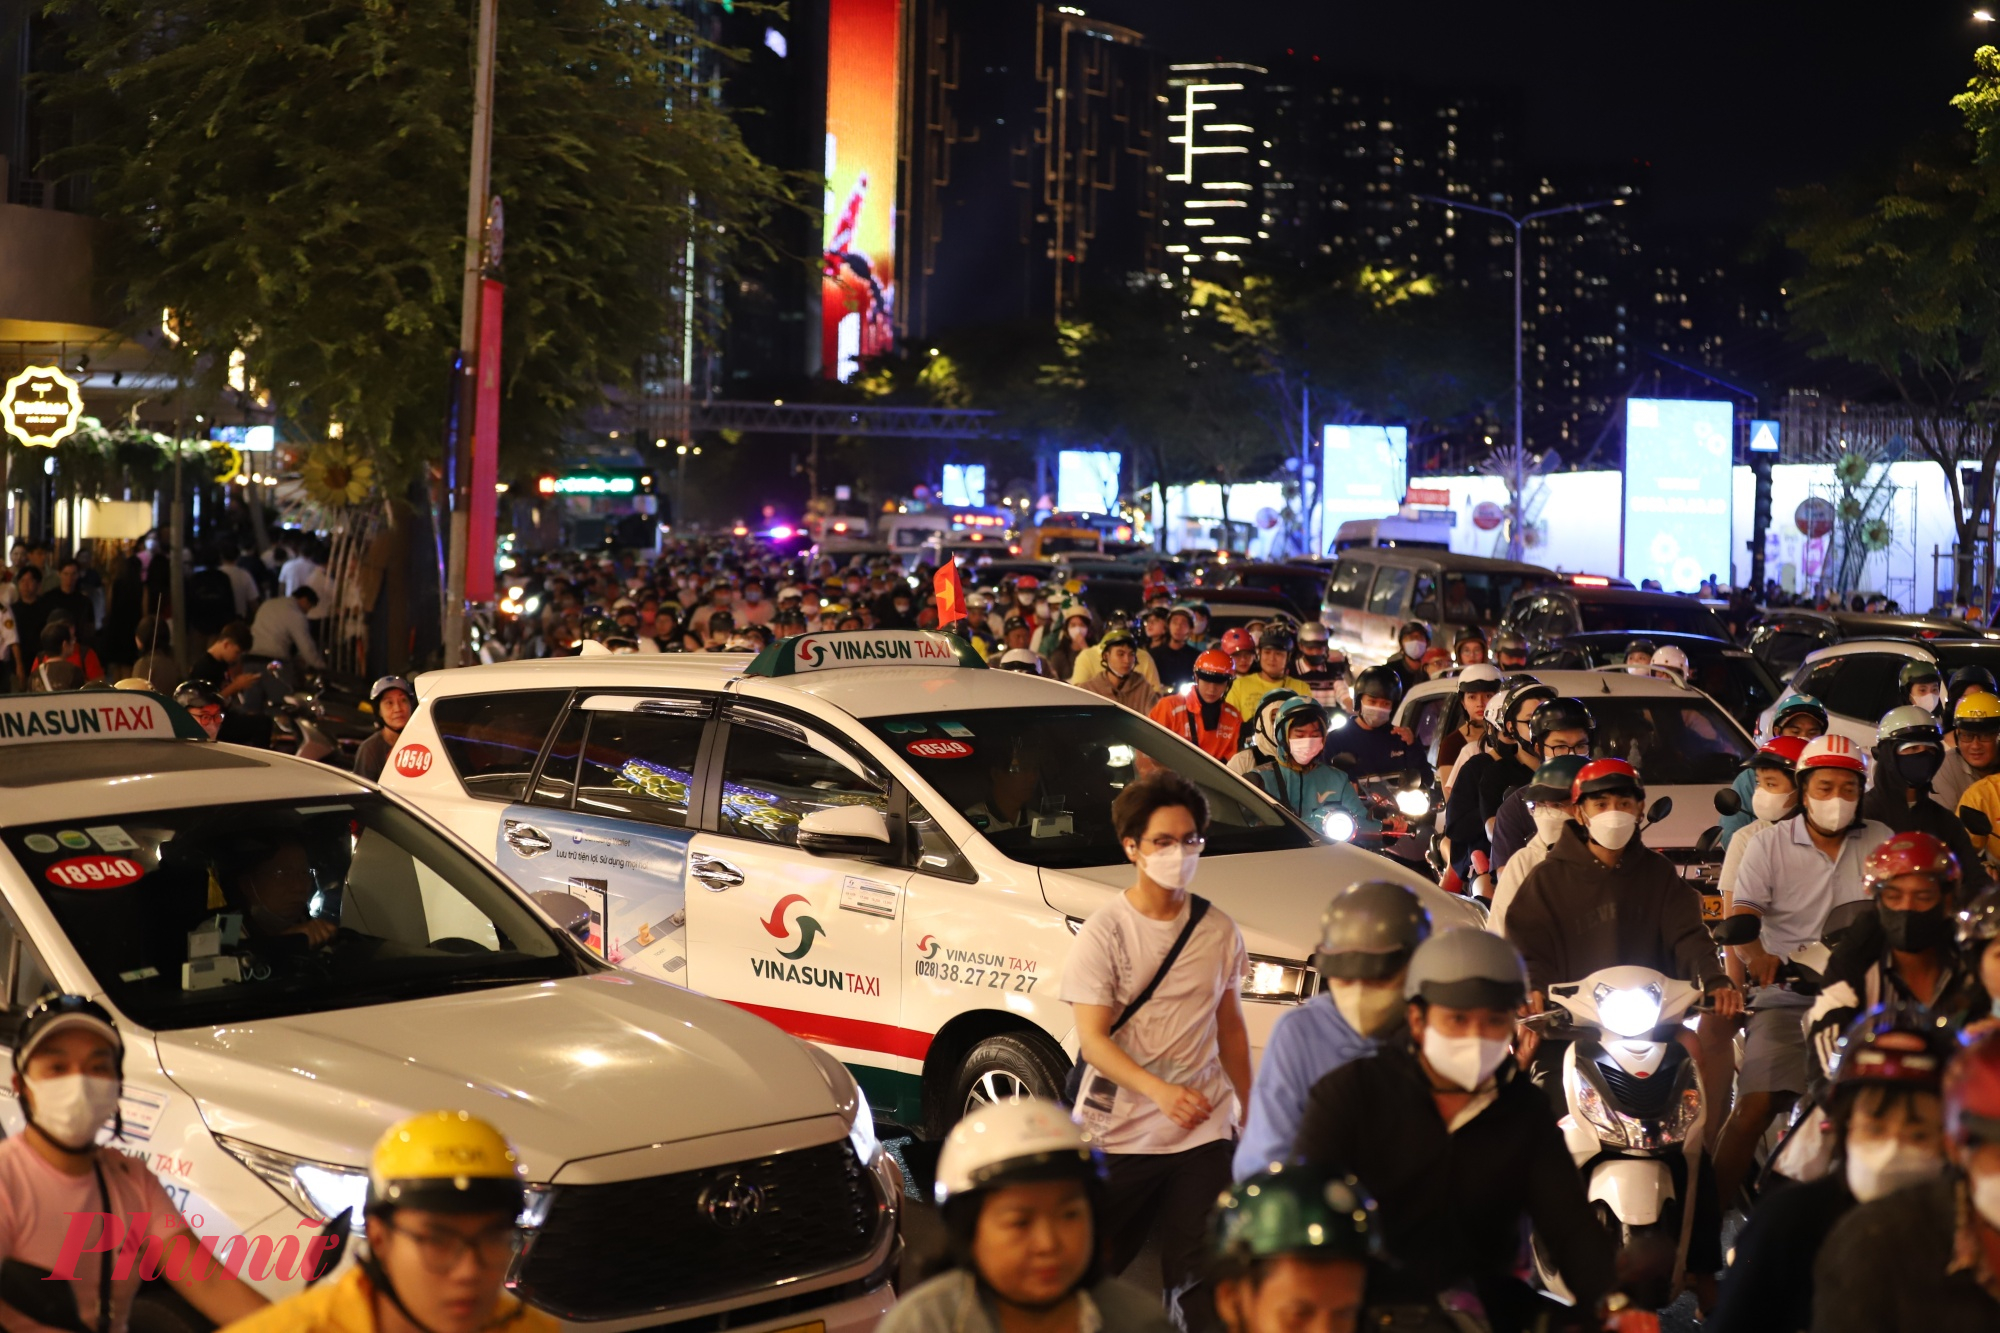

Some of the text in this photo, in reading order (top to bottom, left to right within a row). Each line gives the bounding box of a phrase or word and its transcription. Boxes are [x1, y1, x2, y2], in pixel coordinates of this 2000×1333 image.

[829, 640, 951, 660] VINASUN TAXI
[0, 705, 154, 738] INASUN TAXI
[396, 749, 431, 771] 18549
[910, 742, 967, 756] 18549
[52, 859, 137, 885] 18940
[608, 857, 625, 869] dụng
[946, 949, 1037, 973] VINASUN TAXI
[750, 957, 880, 997] VINASUN TAXI
[987, 970, 1011, 990] 27
[1013, 974, 1038, 994] 27
[156, 1153, 193, 1177] TAXI
